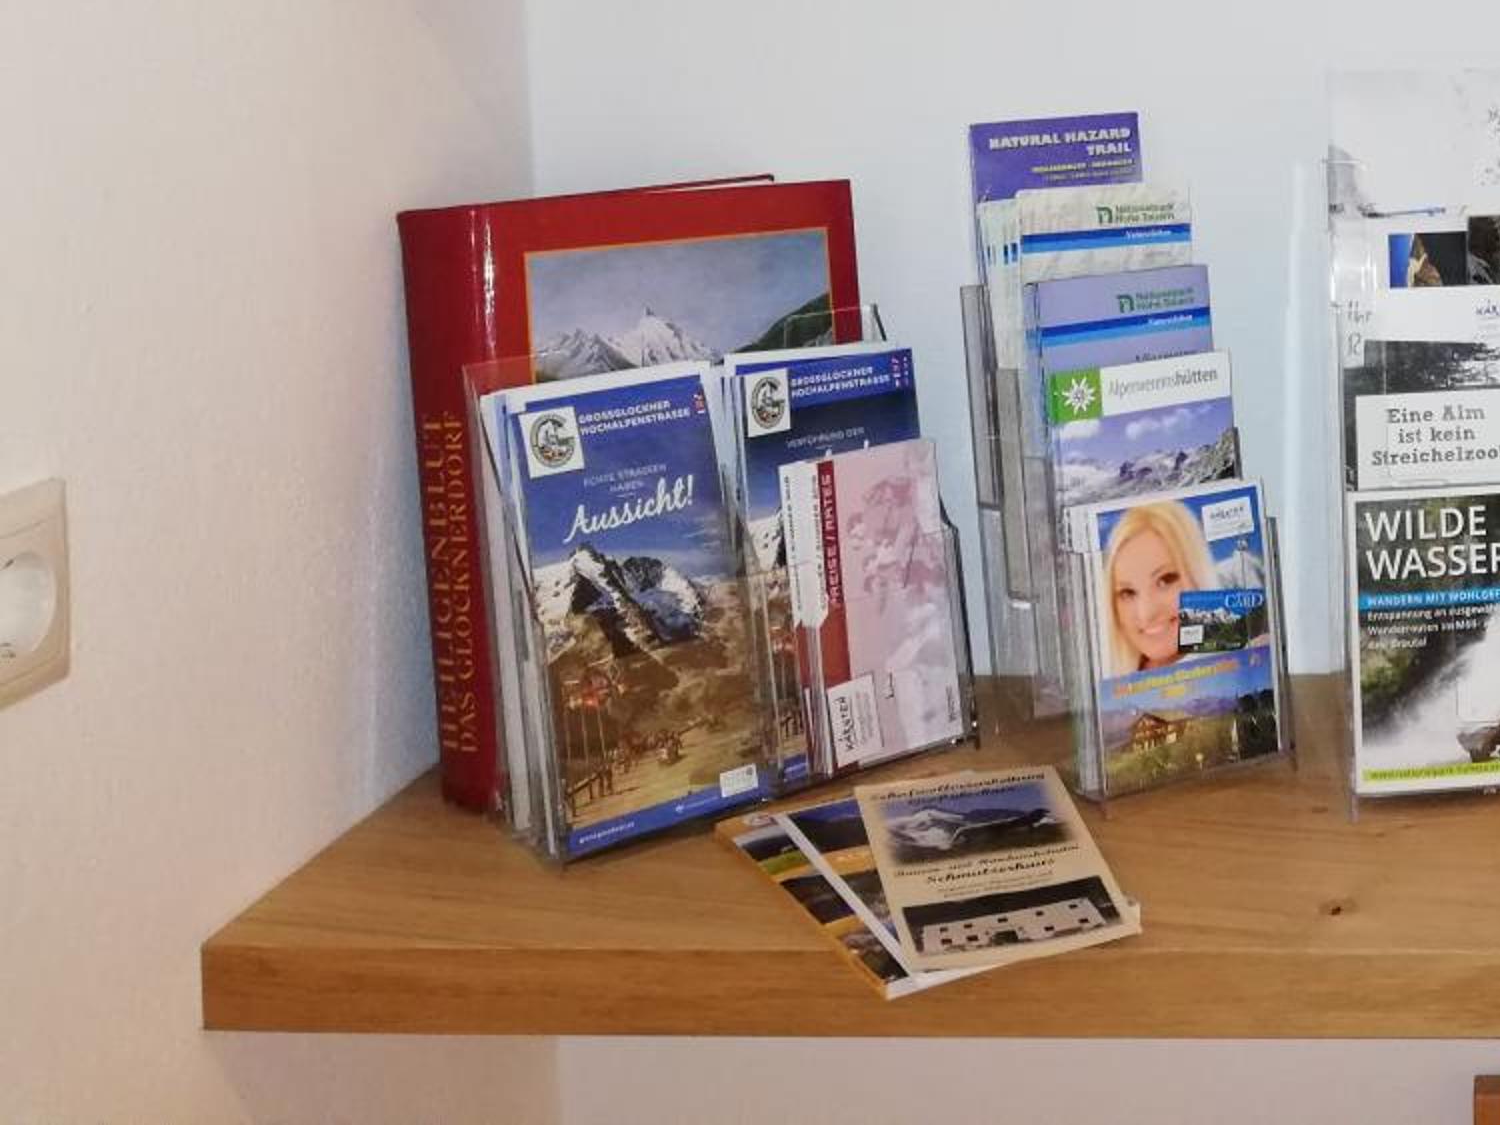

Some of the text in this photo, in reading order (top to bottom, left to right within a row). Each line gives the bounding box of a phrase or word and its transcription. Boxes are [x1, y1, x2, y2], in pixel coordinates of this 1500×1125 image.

[990, 127, 1131, 151] NATURAL HAZARD
[1086, 144, 1132, 156] TRAIL
[790, 365, 873, 387] GROSSGLOCKNER
[790, 374, 891, 398] HOCHALPENSTRASSE
[578, 400, 671, 424] GROSSGLOCKNER
[580, 407, 691, 436] HOCHALPENSTRASSE
[1386, 405, 1486, 424] Eine Alm
[1397, 425, 1477, 444] ist kein
[562, 473, 694, 545] Aussicht!
[822, 474, 835, 532] RATES
[1364, 504, 1488, 543] WILDE
[422, 414, 459, 751] HEILIGENBLUT
[443, 412, 478, 753] DAS GLOCKNERDORF
[1367, 594, 1423, 607] WANDERN
[1425, 592, 1447, 605] MIT
